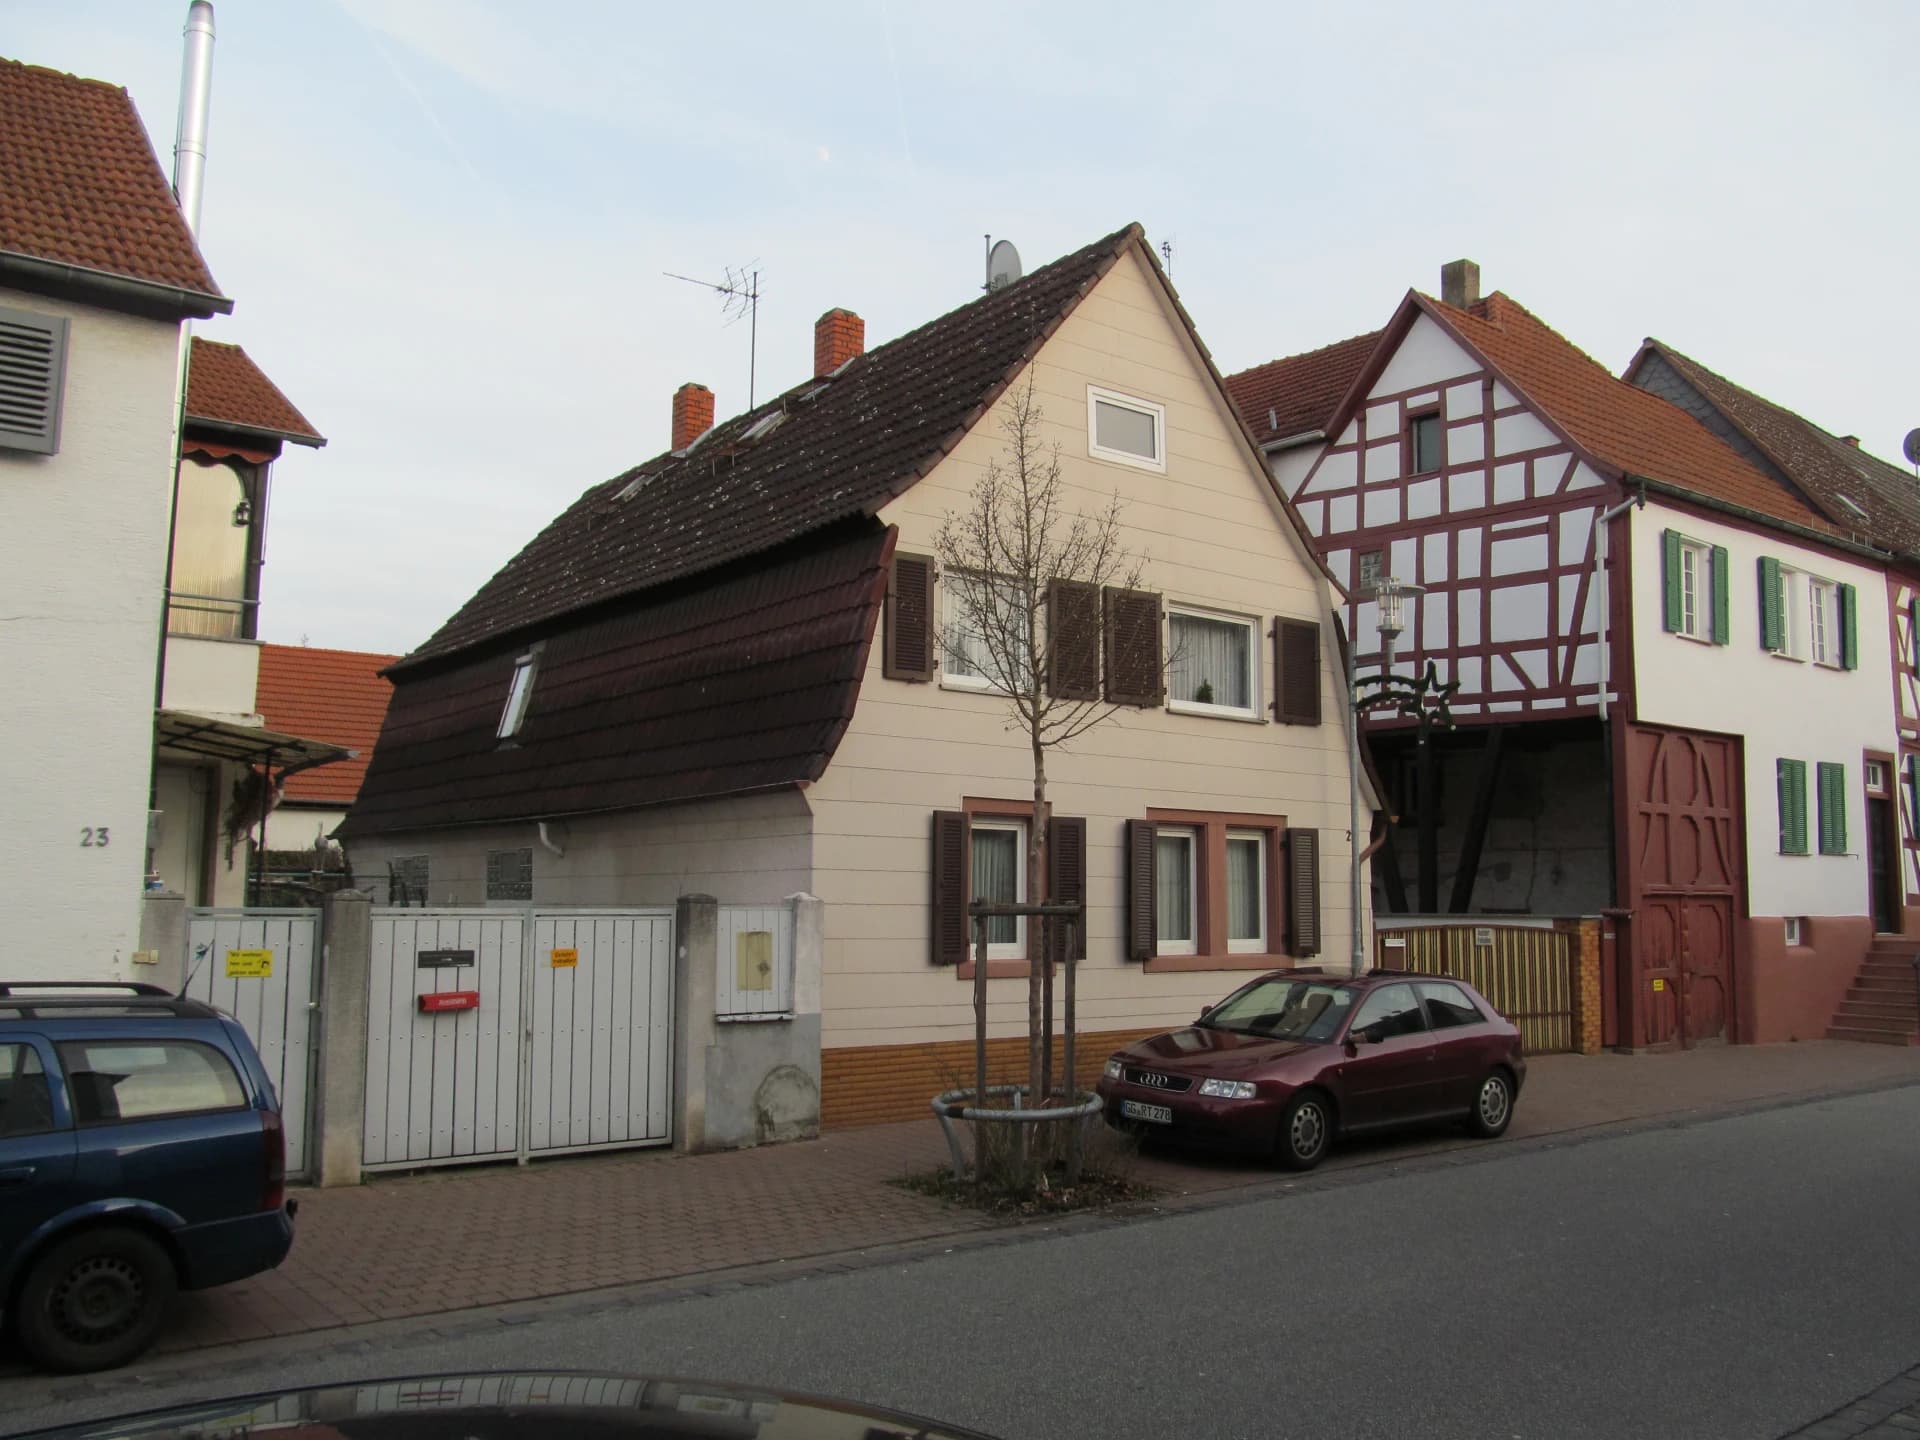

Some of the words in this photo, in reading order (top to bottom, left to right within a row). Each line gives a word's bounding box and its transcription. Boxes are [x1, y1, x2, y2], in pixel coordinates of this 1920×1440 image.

[80, 827, 109, 847] 23
[1126, 1102, 1136, 1114] GG
[1140, 1104, 1152, 1117] RT
[1153, 1107, 1170, 1121] 278
